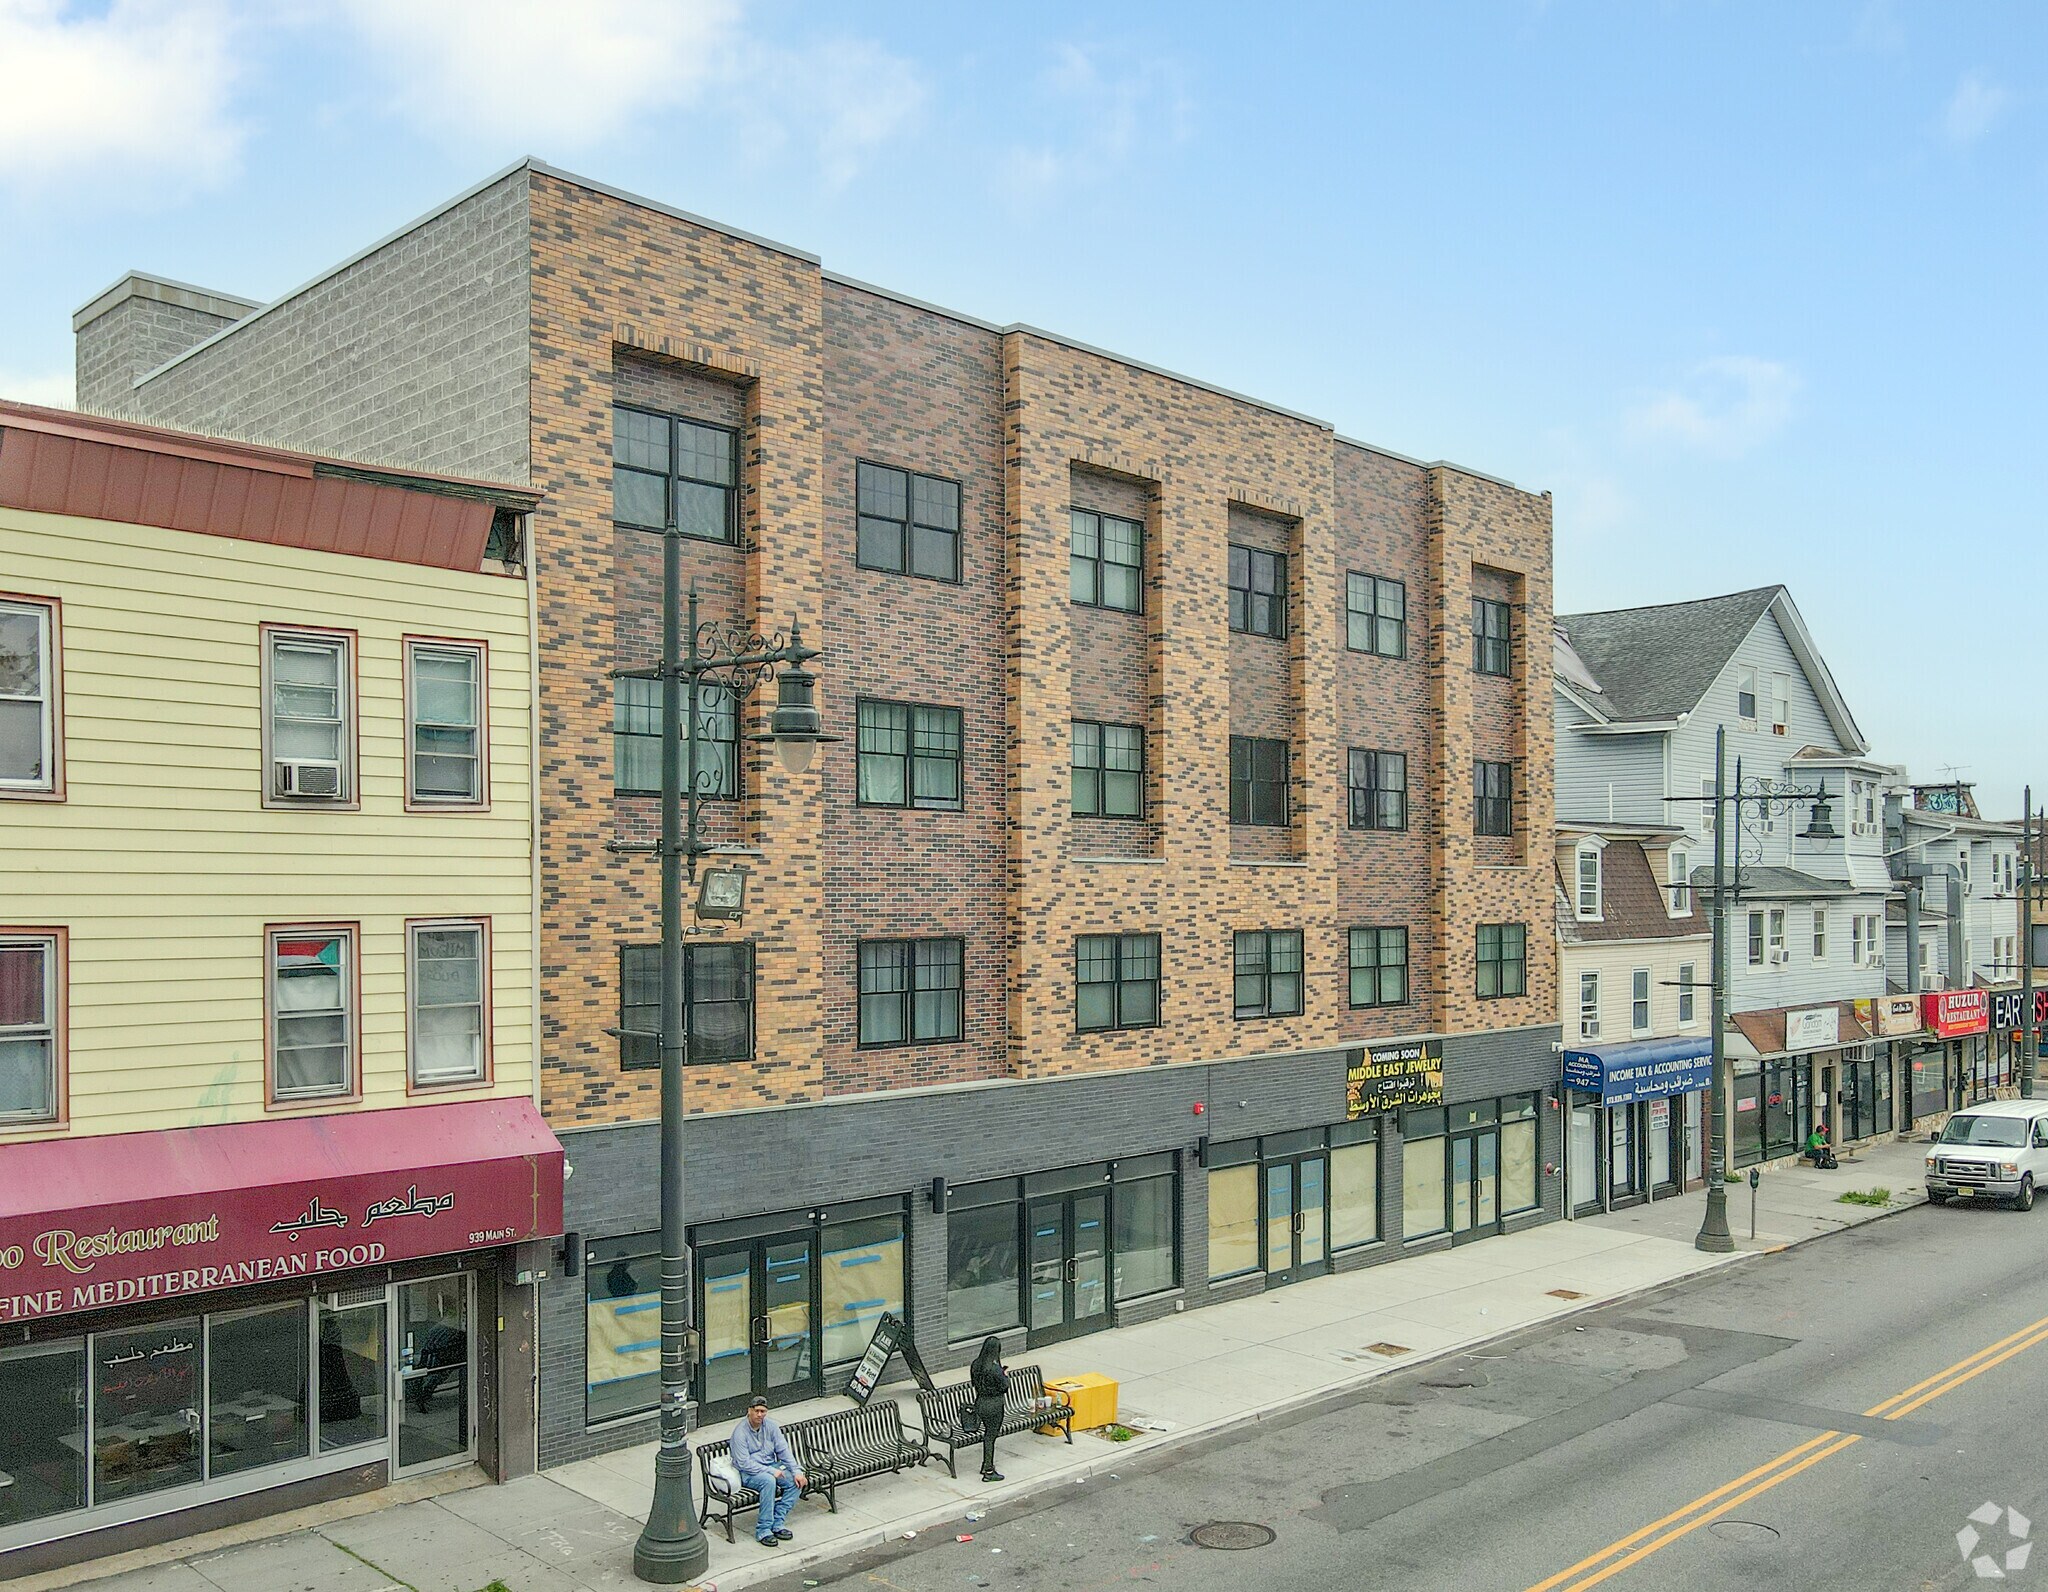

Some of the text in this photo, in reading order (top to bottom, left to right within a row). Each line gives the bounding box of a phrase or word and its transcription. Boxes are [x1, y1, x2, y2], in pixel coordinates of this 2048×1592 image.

[1948, 993, 1979, 1009] HUZUR
[1947, 1009, 1980, 1023] RESTAURANT
[1372, 1049, 1419, 1062] COMING SOON
[1348, 1058, 1441, 1081] MIDDLE EAST JEWELRY
[1568, 1061, 1599, 1070] ACCOUNTING
[1608, 1069, 1634, 1083] INCOME
[1635, 1067, 1647, 1078] TAX
[1648, 1065, 1653, 1076] &
[1654, 1059, 1693, 1075] ACCOUNTING
[1575, 1078, 1590, 1086] 947
[1670, 1073, 1693, 1092] ضرائب
[1381, 1092, 1406, 1110] الشرق
[1408, 1090, 1441, 1105] مجوهرات
[268, 1184, 454, 1242] مطعم حلب
[33, 1213, 219, 1274] Restaurant
[469, 1231, 485, 1244] 939
[0, 1243, 385, 1319] FINE MEDITERRANEAN FOOD
[102, 1337, 194, 1369] مطعم حلب
